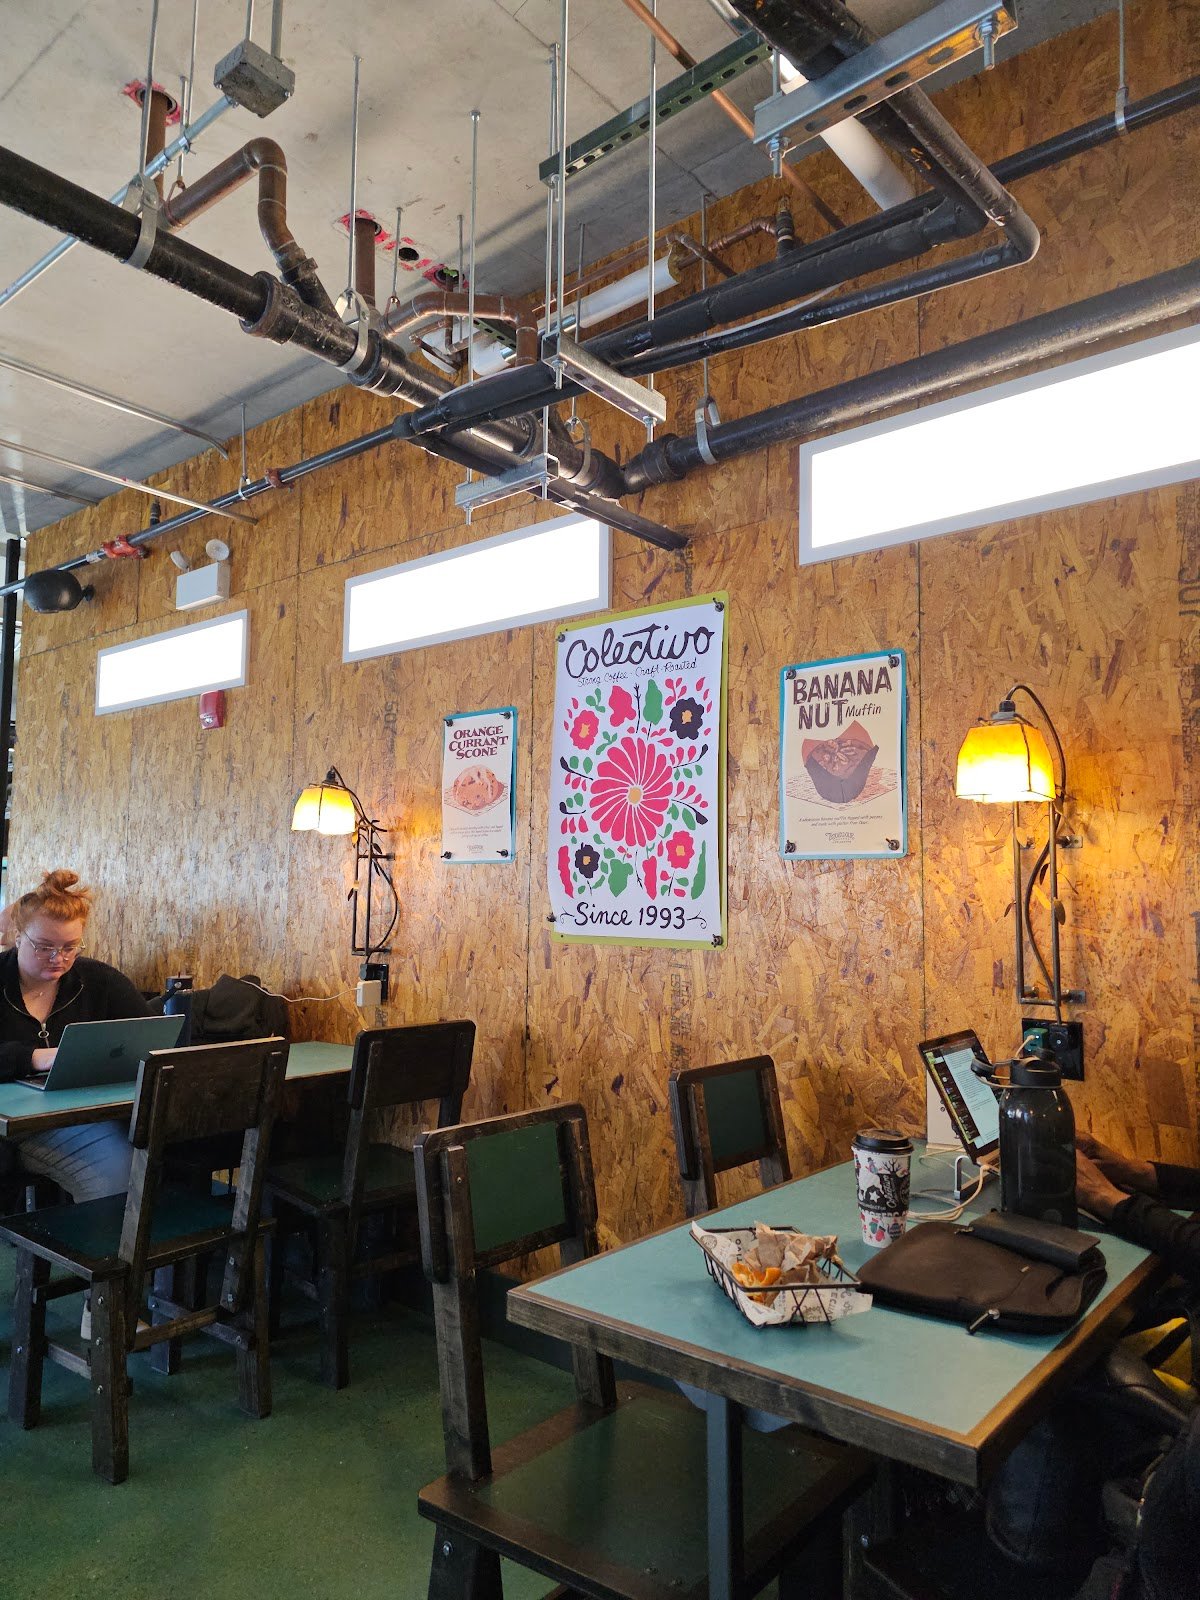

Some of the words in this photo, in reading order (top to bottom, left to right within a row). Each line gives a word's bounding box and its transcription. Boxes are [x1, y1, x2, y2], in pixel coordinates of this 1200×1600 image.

[565, 623, 715, 679] Colectivo
[577, 676, 602, 688] Strong
[603, 671, 629, 684] Coffee
[793, 666, 892, 705] BANANA
[798, 698, 849, 730] NUT
[845, 702, 882, 718] Muffin
[448, 735, 509, 752] CURRANT
[453, 725, 504, 740] ORANGE
[456, 746, 498, 760] SCONE
[574, 901, 633, 927] Since
[639, 905, 686, 930] 1993
